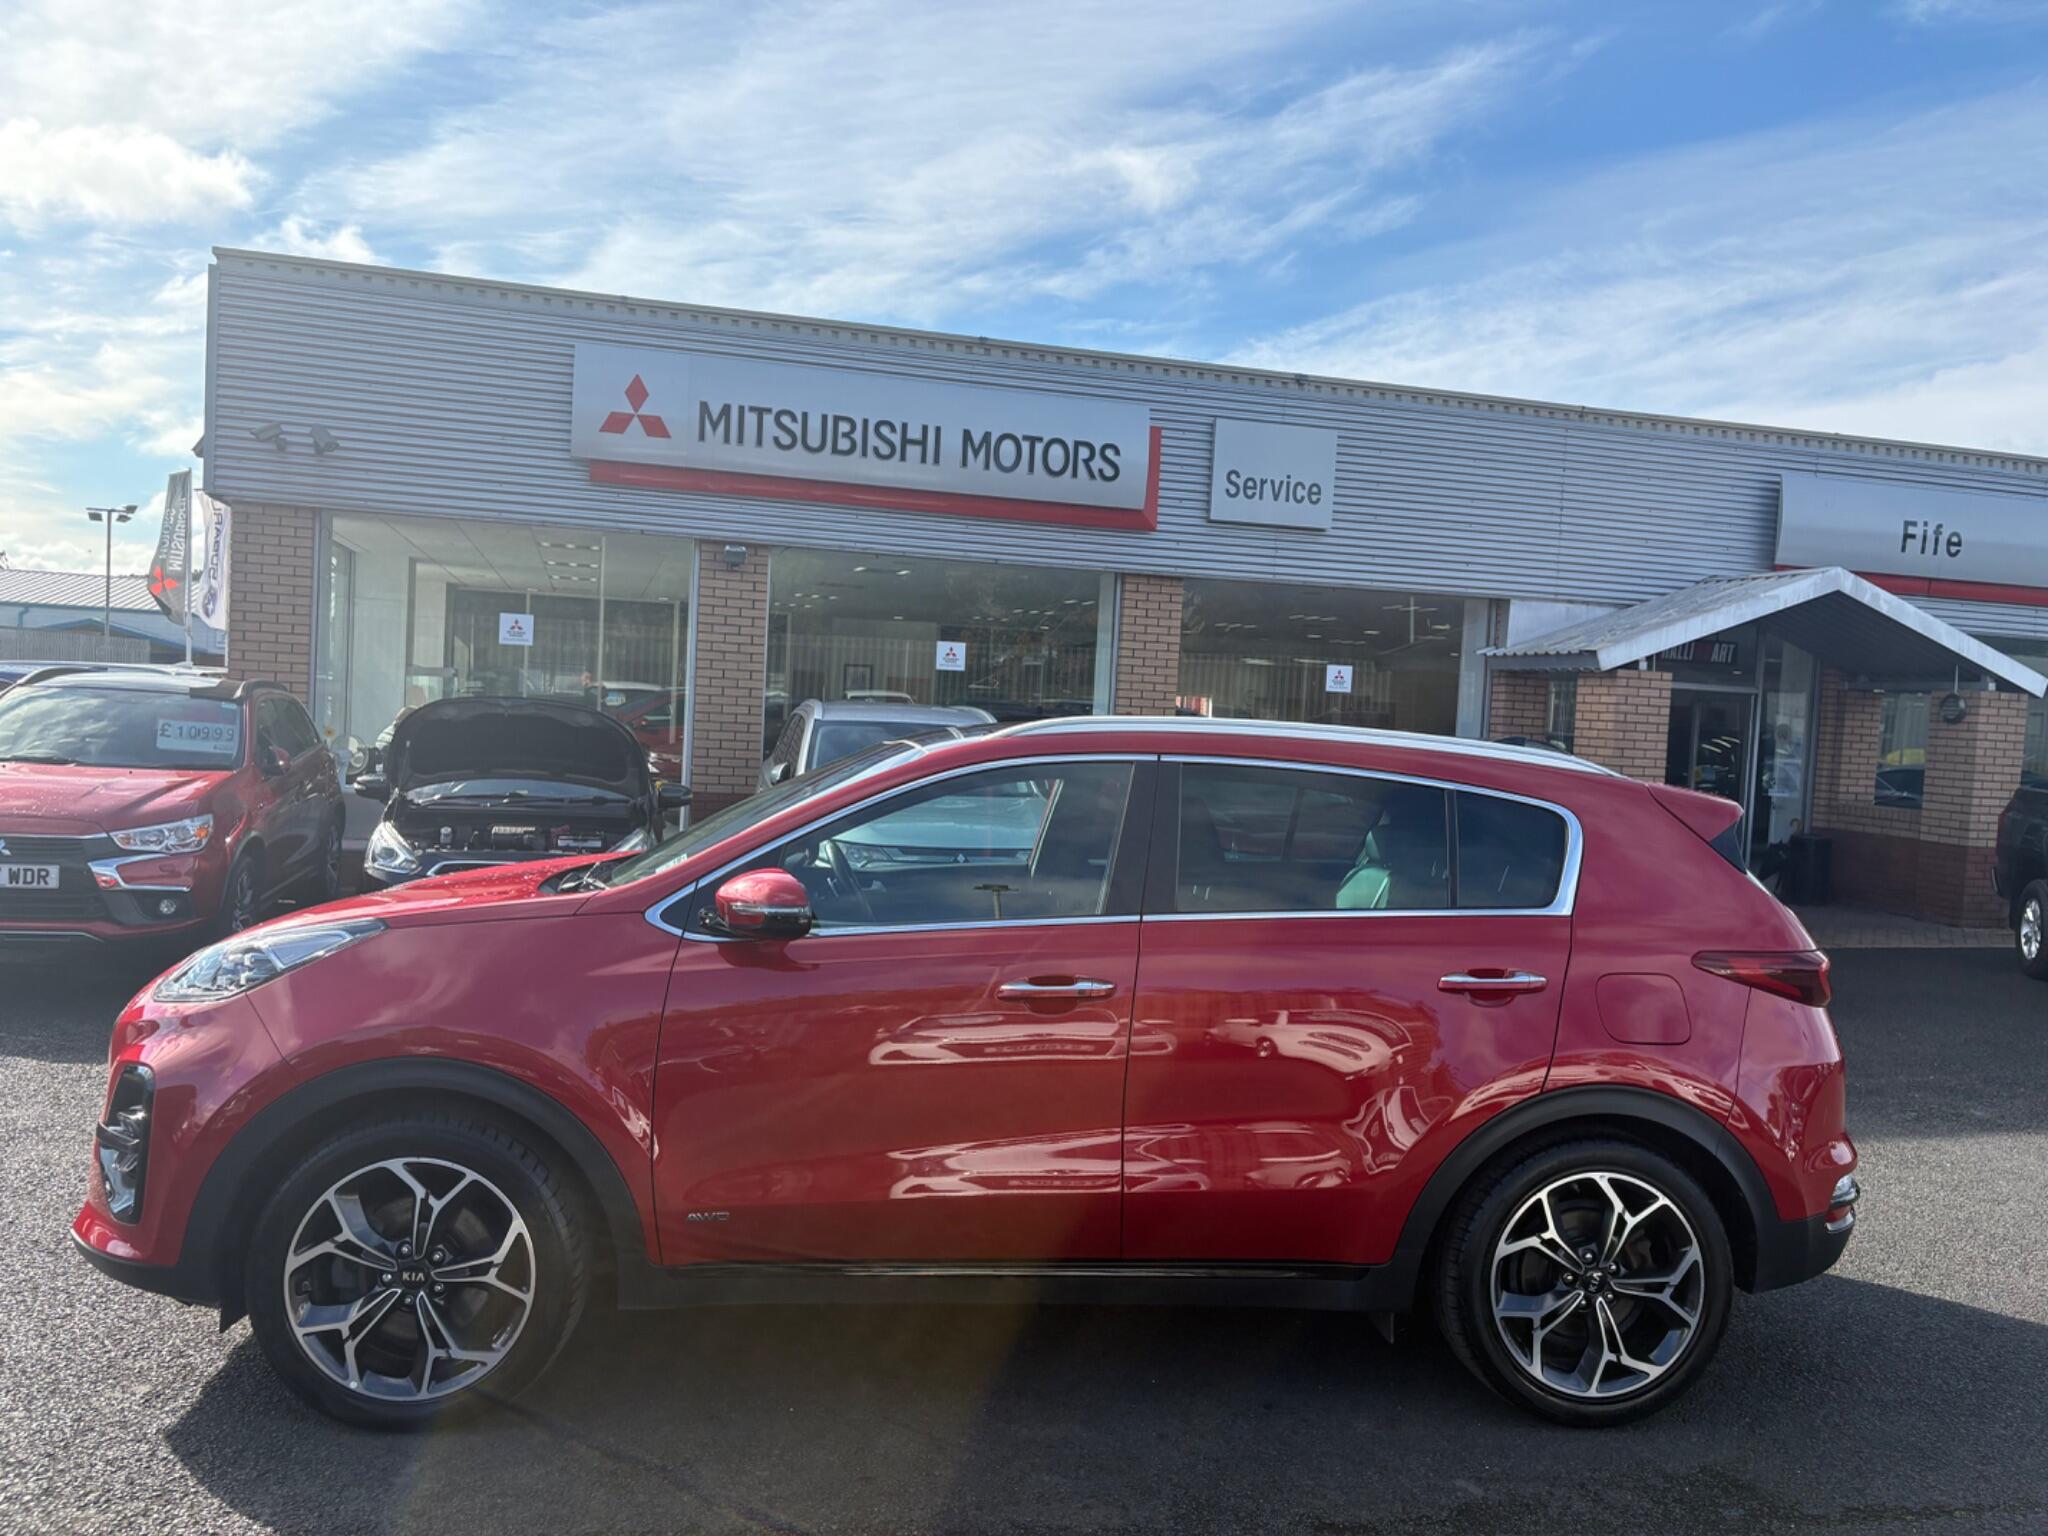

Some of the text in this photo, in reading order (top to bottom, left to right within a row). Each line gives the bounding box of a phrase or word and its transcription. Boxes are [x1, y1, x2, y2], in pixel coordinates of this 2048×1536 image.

[698, 400, 1123, 483] MITSUBISHI MOTORS
[1225, 469, 1322, 505] Service
[1901, 519, 1963, 558] Fife
[8, 867, 50, 886] WDR
[402, 1271, 426, 1282] KIA
